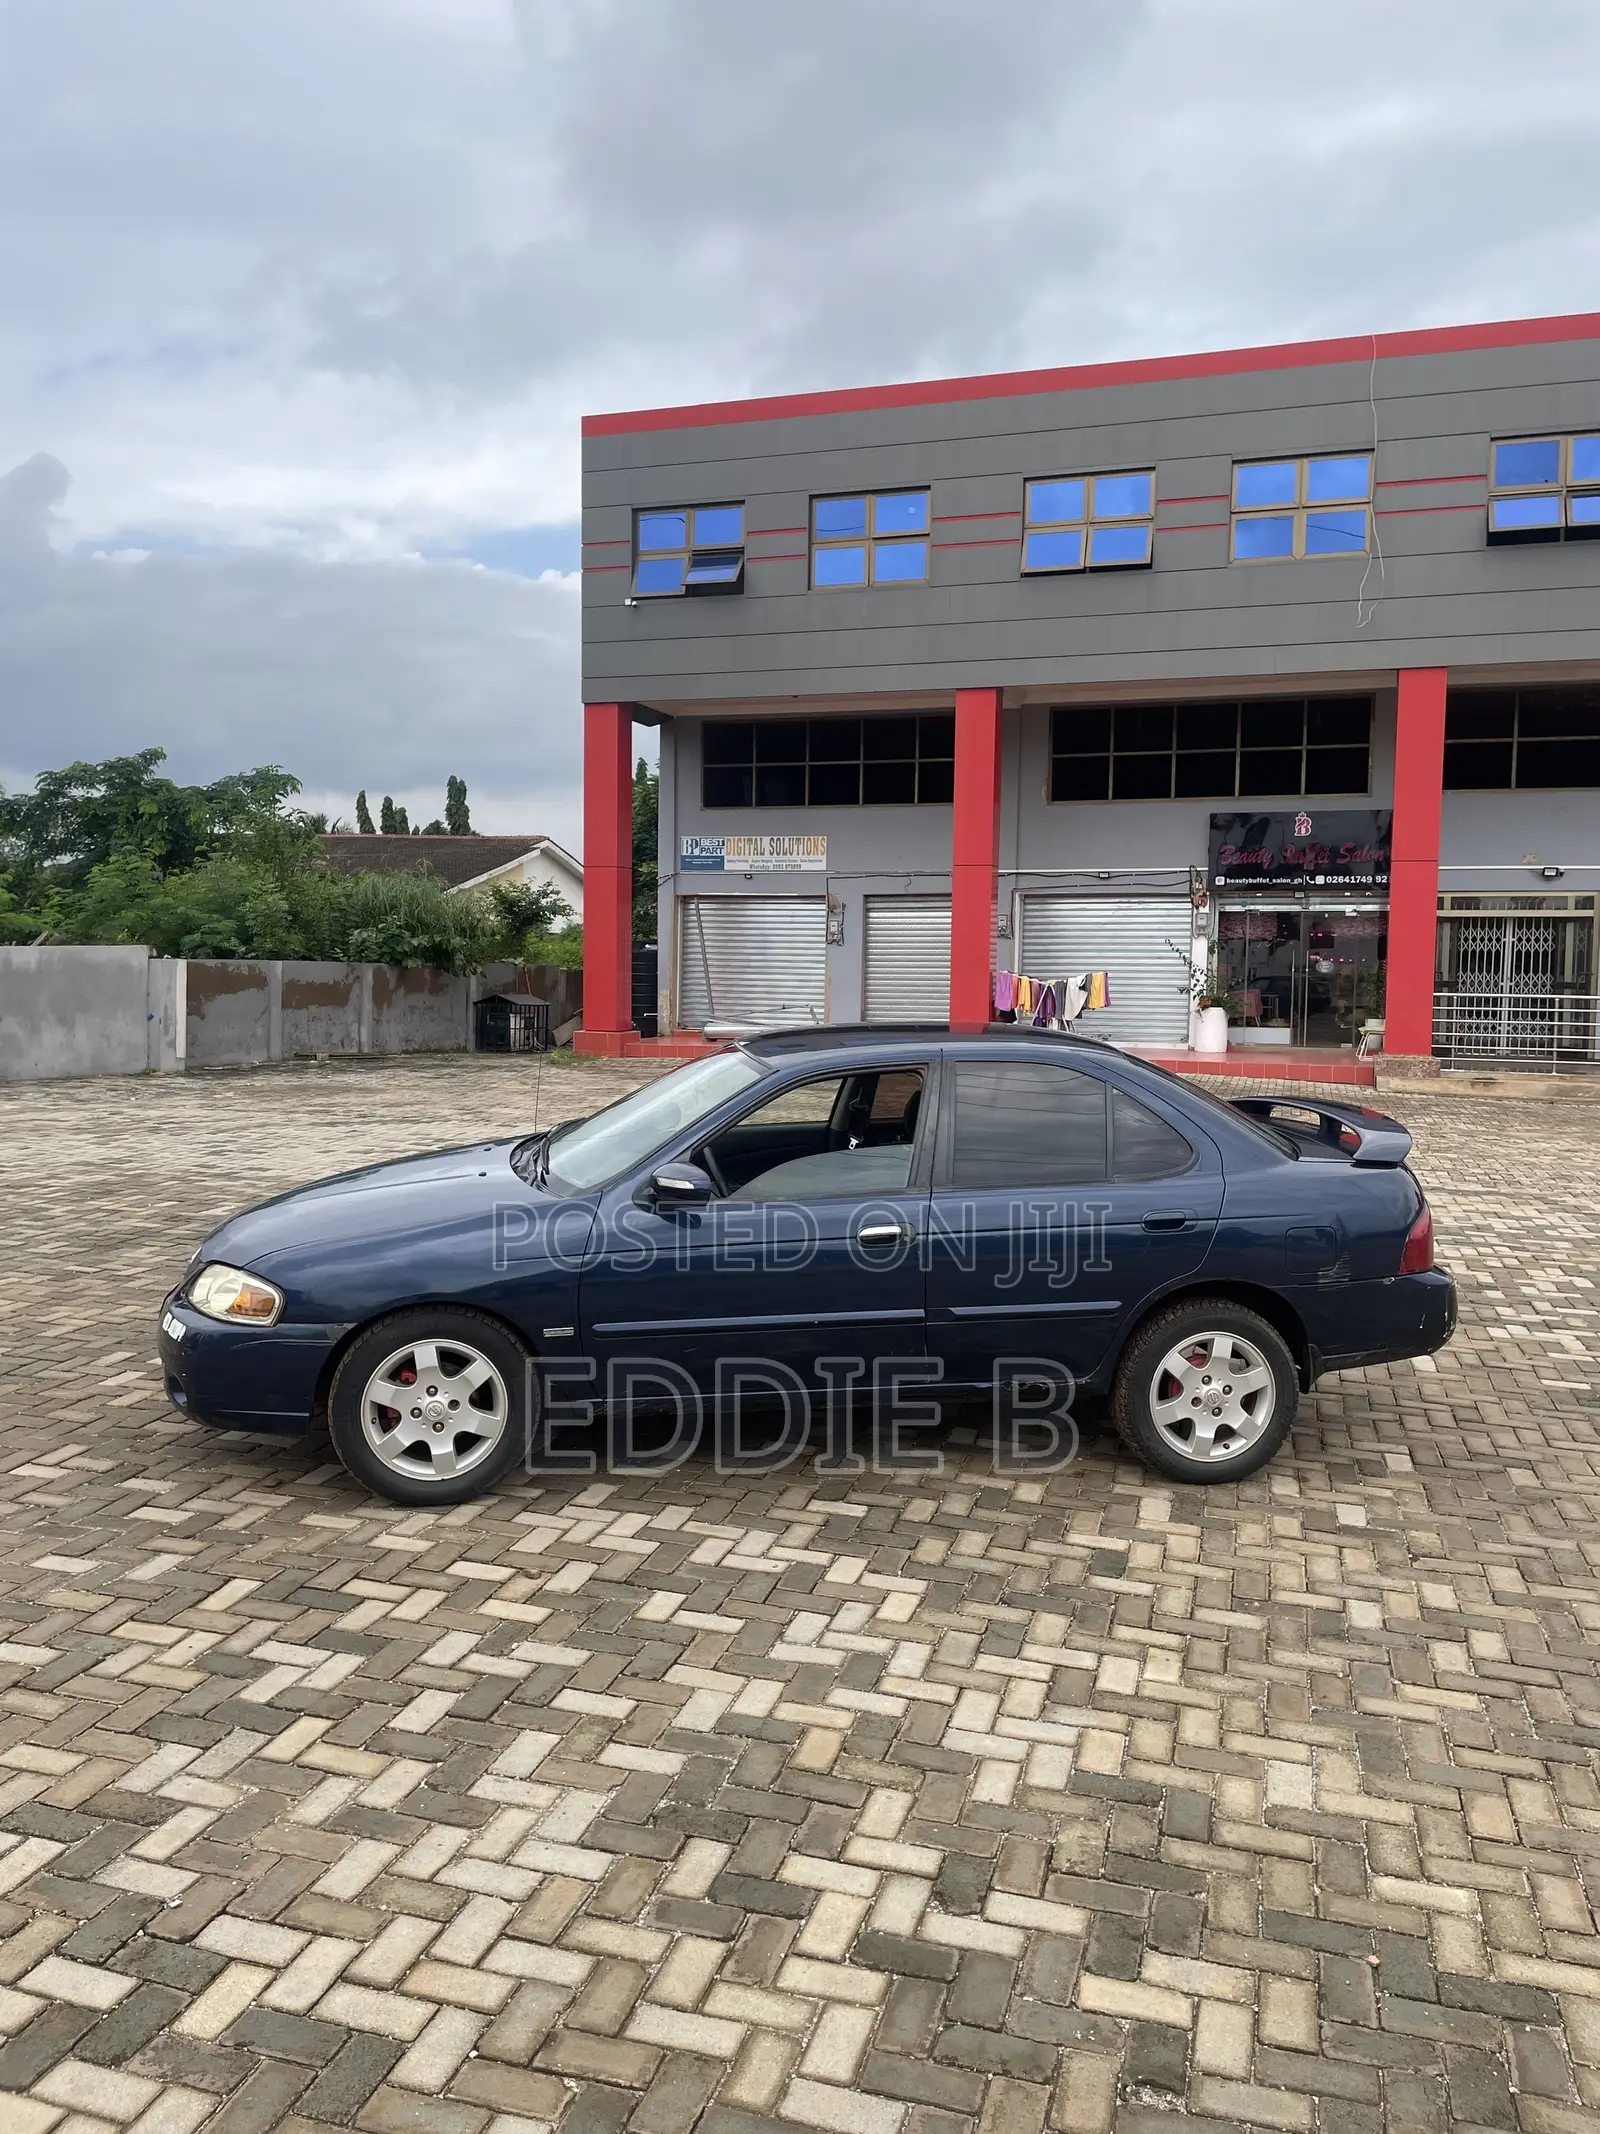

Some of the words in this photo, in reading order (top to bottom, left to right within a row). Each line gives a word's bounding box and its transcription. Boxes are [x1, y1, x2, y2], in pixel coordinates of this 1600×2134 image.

[700, 837, 724, 846] BEST
[725, 837, 765, 856] DIGITAL
[769, 837, 826, 856] SOLUTIONS
[700, 847, 724, 855] PART
[1220, 844, 1272, 869] Beauty
[1336, 842, 1385, 864] Salon
[1226, 877, 1303, 885] beautybuffet_salon_gh
[1375, 875, 1391, 883] 92
